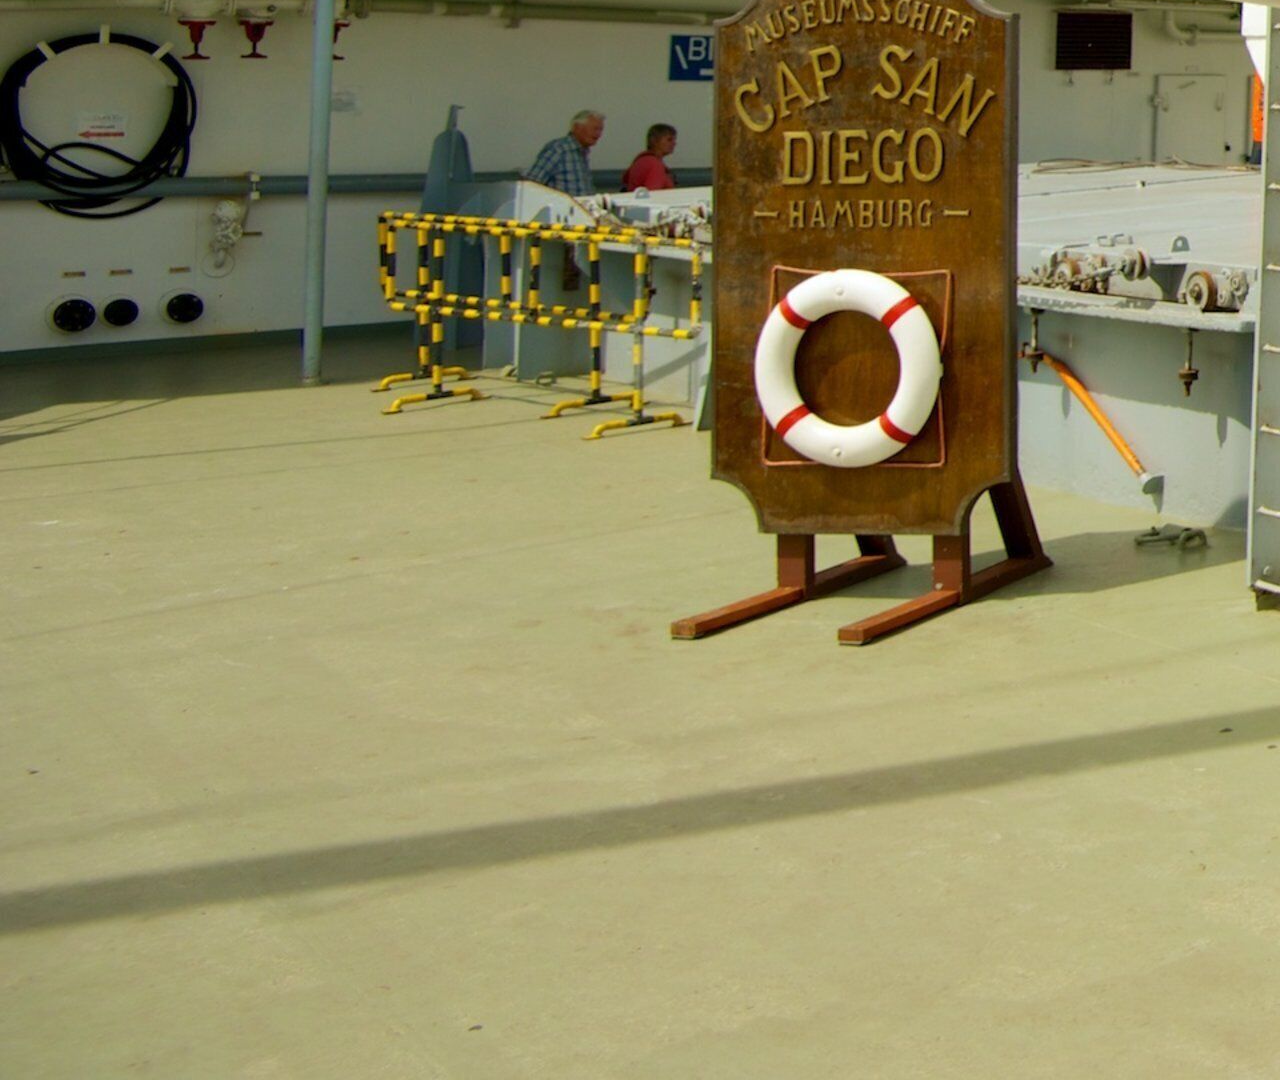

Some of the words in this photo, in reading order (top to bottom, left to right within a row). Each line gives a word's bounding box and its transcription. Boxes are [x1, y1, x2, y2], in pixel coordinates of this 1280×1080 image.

[735, 45, 843, 133] CAP
[871, 45, 996, 138] SAN
[782, 128, 944, 186] DIEGO
[788, 199, 934, 228] HAMBURG
